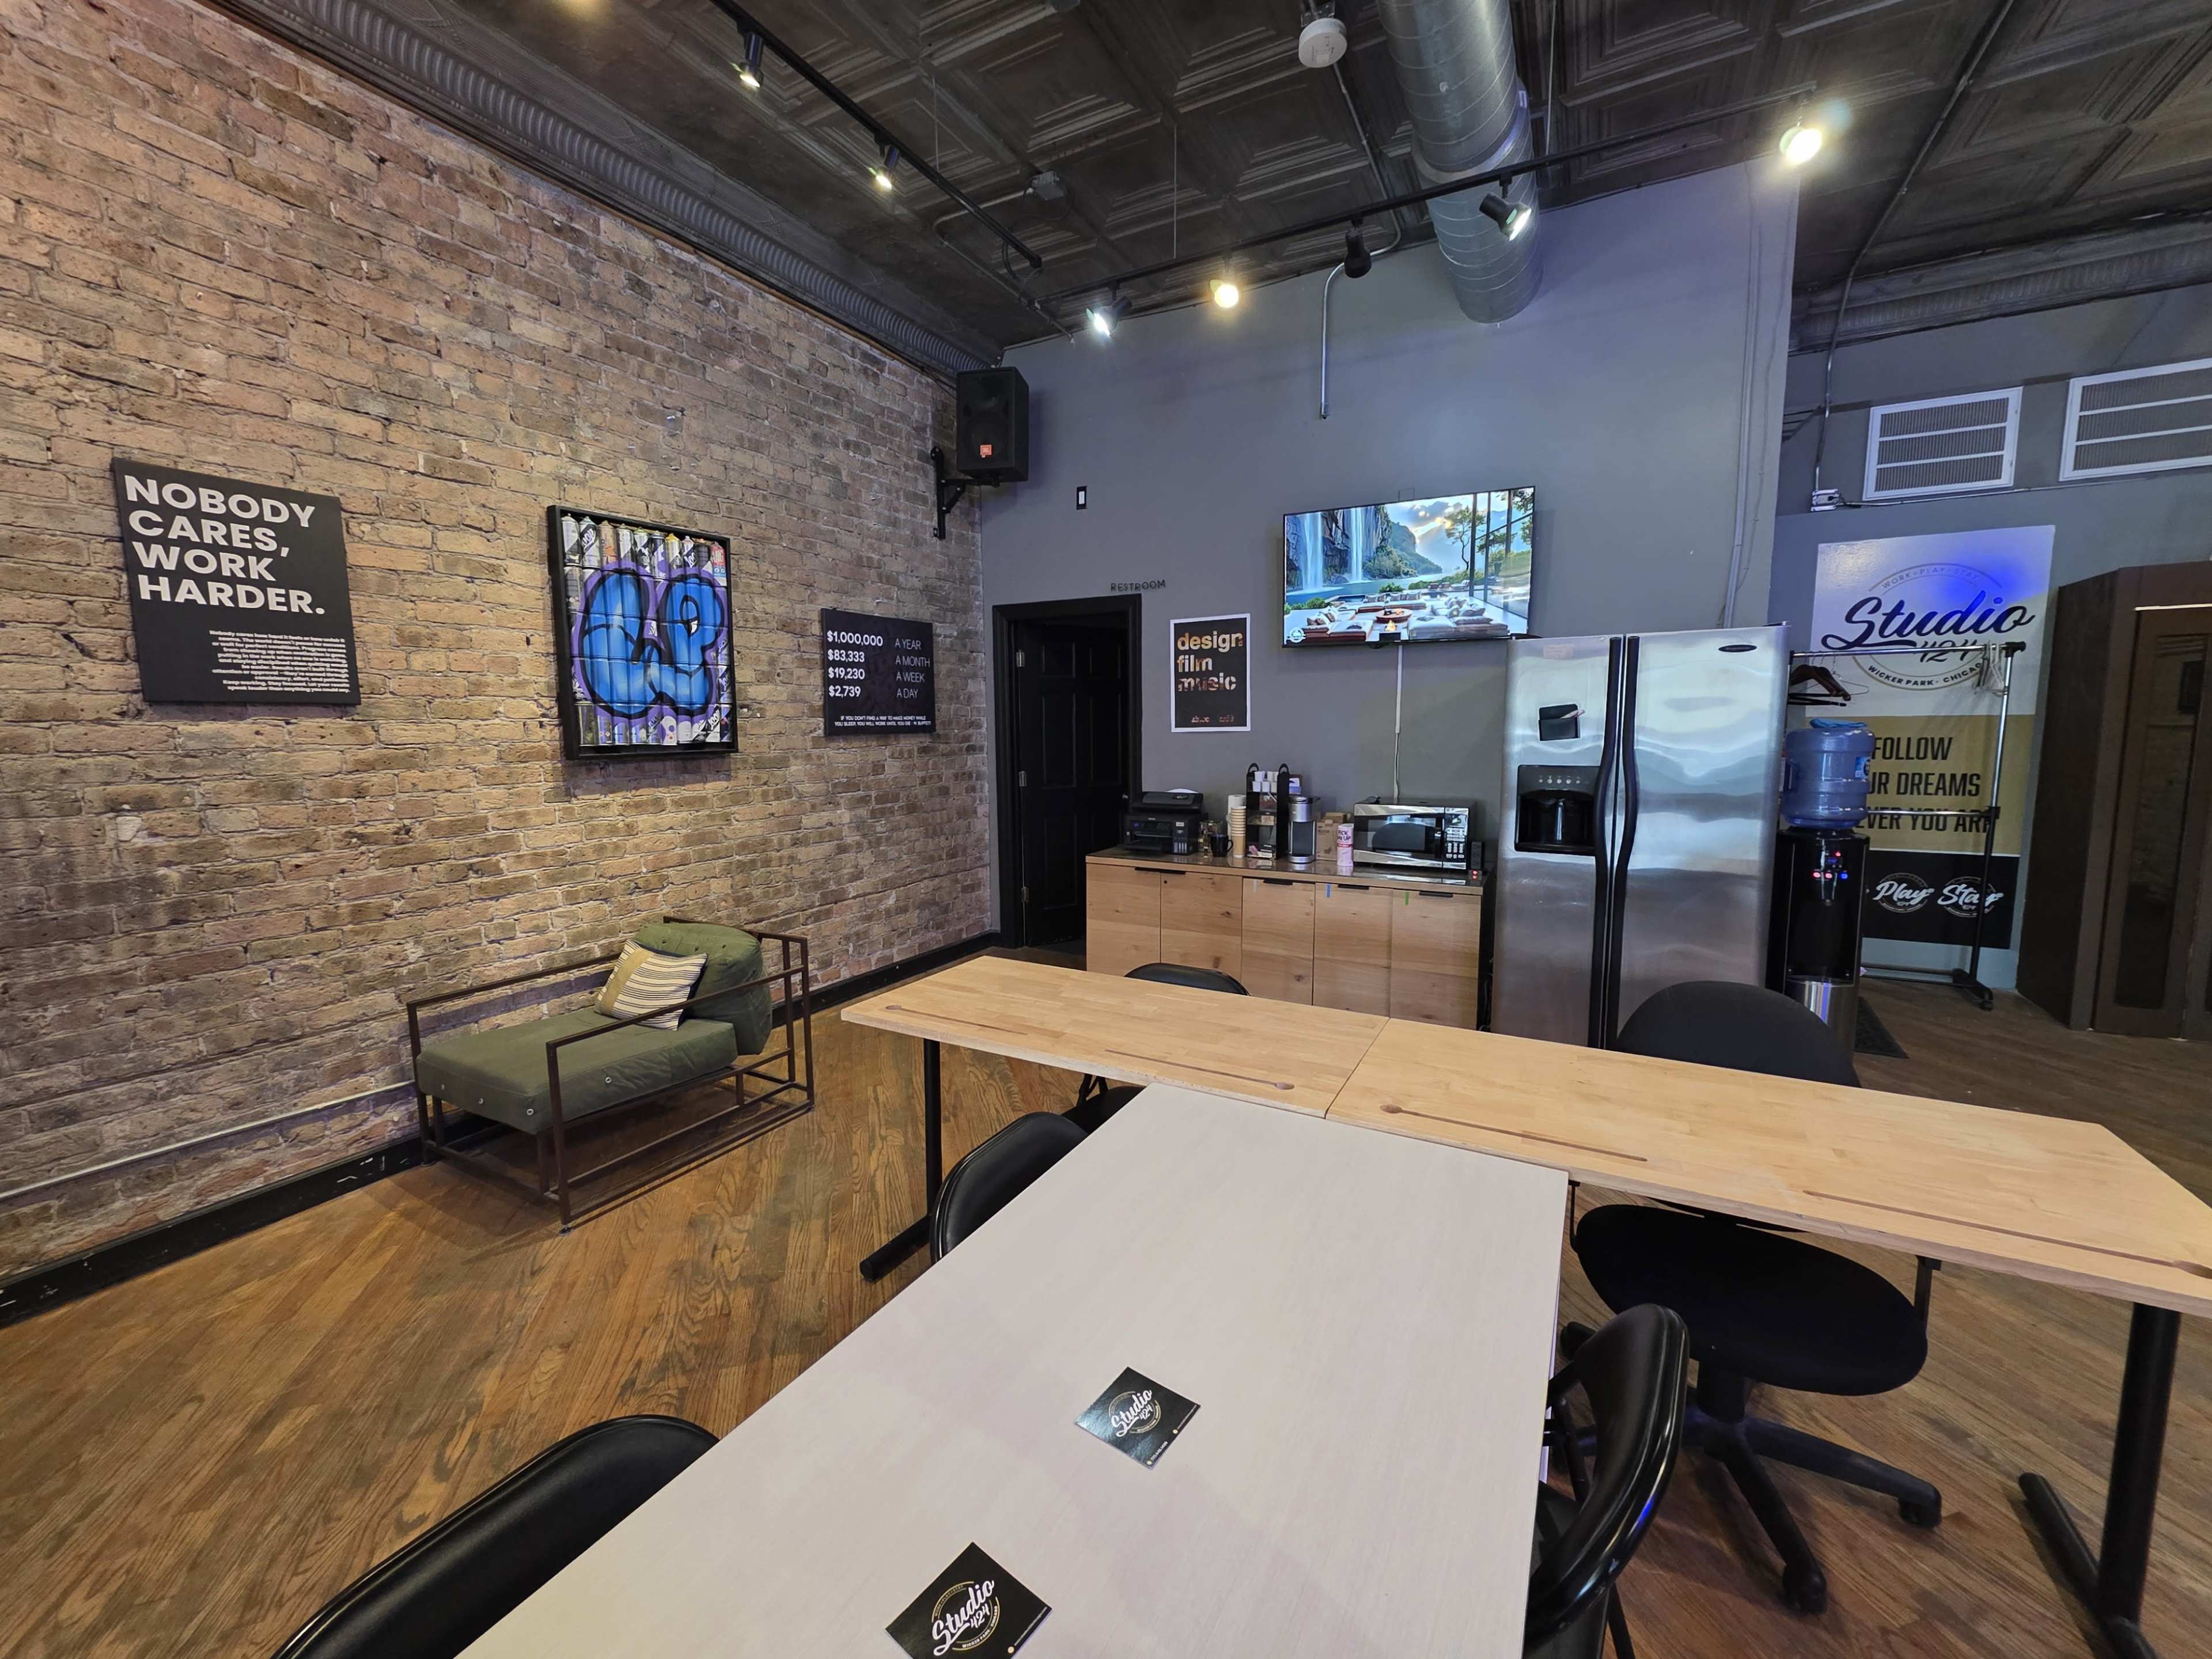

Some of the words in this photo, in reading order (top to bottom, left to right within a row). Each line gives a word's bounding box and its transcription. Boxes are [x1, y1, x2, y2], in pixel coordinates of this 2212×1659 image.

[124, 475, 315, 527] NOBODY
[128, 510, 290, 557] CARES,
[131, 541, 276, 581] WORK
[1111, 579, 1166, 592] RESTROOM
[1882, 571, 1912, 589] WORK
[1919, 567, 1945, 575] PLAY
[138, 574, 325, 615] HARDER.
[1821, 590, 2036, 650] Studio
[827, 630, 883, 646] $1,000,000
[895, 638, 900, 648] A
[902, 639, 922, 650] YEAR
[1177, 631, 1243, 653] design
[827, 649, 865, 662] $83,333
[895, 655, 902, 665] A
[902, 656, 930, 668] MONTH
[1177, 654, 1213, 672] film
[828, 666, 865, 680] $19,230
[896, 671, 902, 681] A
[903, 672, 925, 683] WEEK
[1178, 672, 1236, 692] music
[1868, 665, 1903, 684] WICKER
[1943, 662, 1982, 683] CHICAG
[828, 685, 861, 698] $2,739
[896, 688, 903, 698] A
[903, 688, 918, 698] DAY
[1872, 736, 1953, 761] FOLLOW
[1896, 772, 1982, 797] DREAMS
[1872, 881, 1935, 905] Play
[1111, 1390, 1153, 1437] Studio
[1139, 1405, 1154, 1421] 424
[931, 1580, 995, 1656] Studio
[969, 1603, 990, 1628] 424
